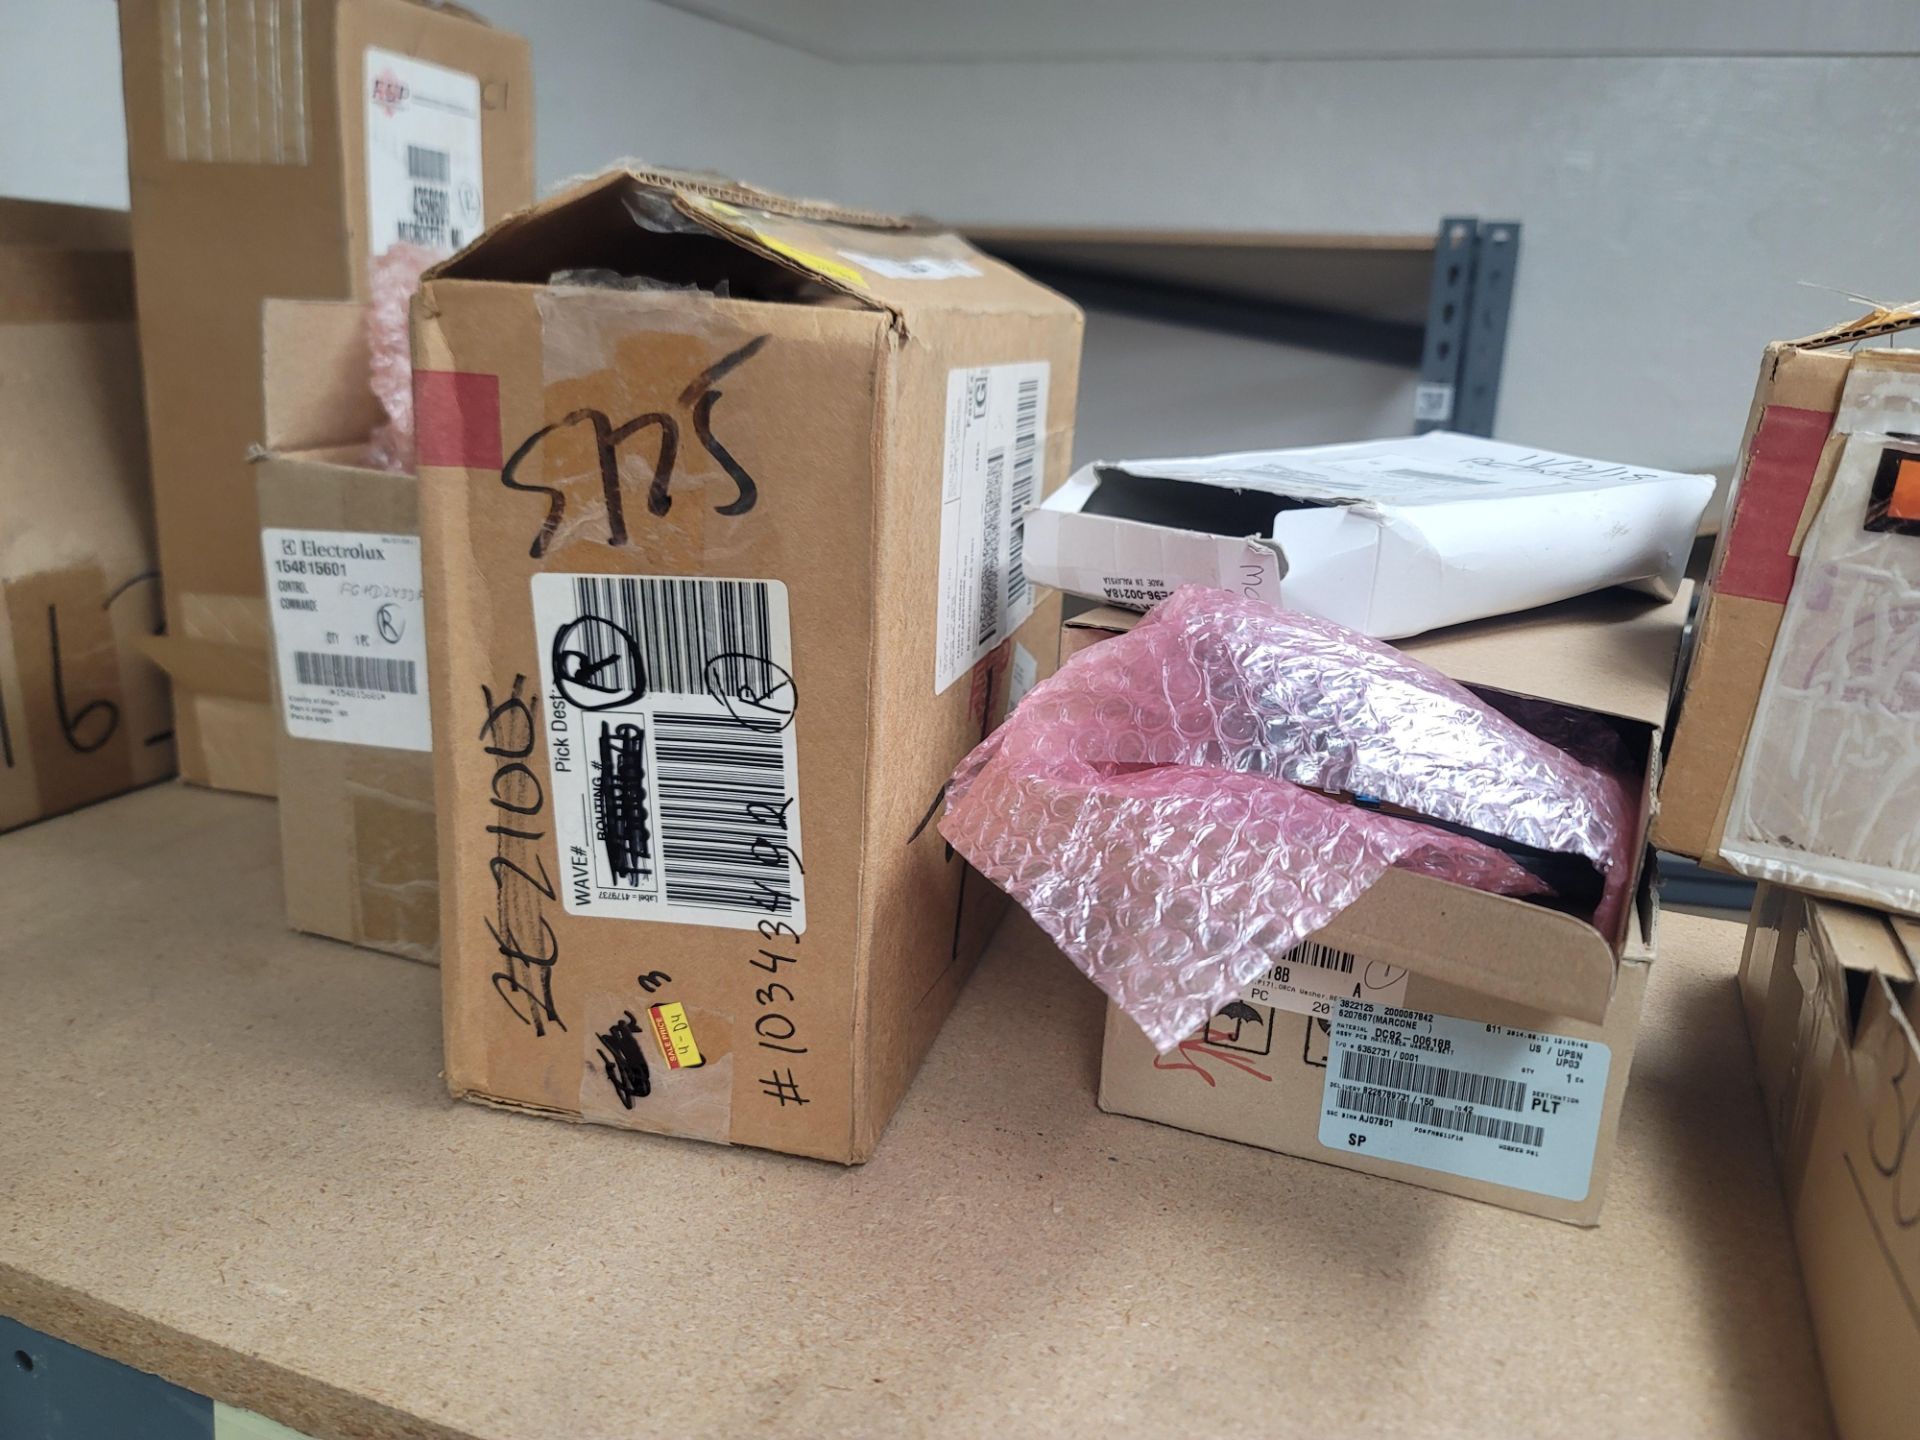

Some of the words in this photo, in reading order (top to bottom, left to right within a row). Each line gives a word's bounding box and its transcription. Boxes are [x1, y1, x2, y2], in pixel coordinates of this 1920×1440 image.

[302, 540, 386, 561] Electrolux
[276, 560, 347, 577] 154815601
[554, 725, 572, 773] Pick
[570, 844, 592, 906] WAVE#
[638, 890, 658, 903] Label
[1251, 988, 1270, 1001] PC
[1352, 982, 1361, 998] A
[655, 1016, 671, 1042] PRICE
[663, 1040, 679, 1064] SALE
[1529, 1043, 1542, 1053] US
[1400, 1051, 1419, 1063] 0001
[1463, 1105, 1474, 1114] 42
[1531, 1097, 1561, 1114] PLT
[1348, 1132, 1367, 1147] SP
